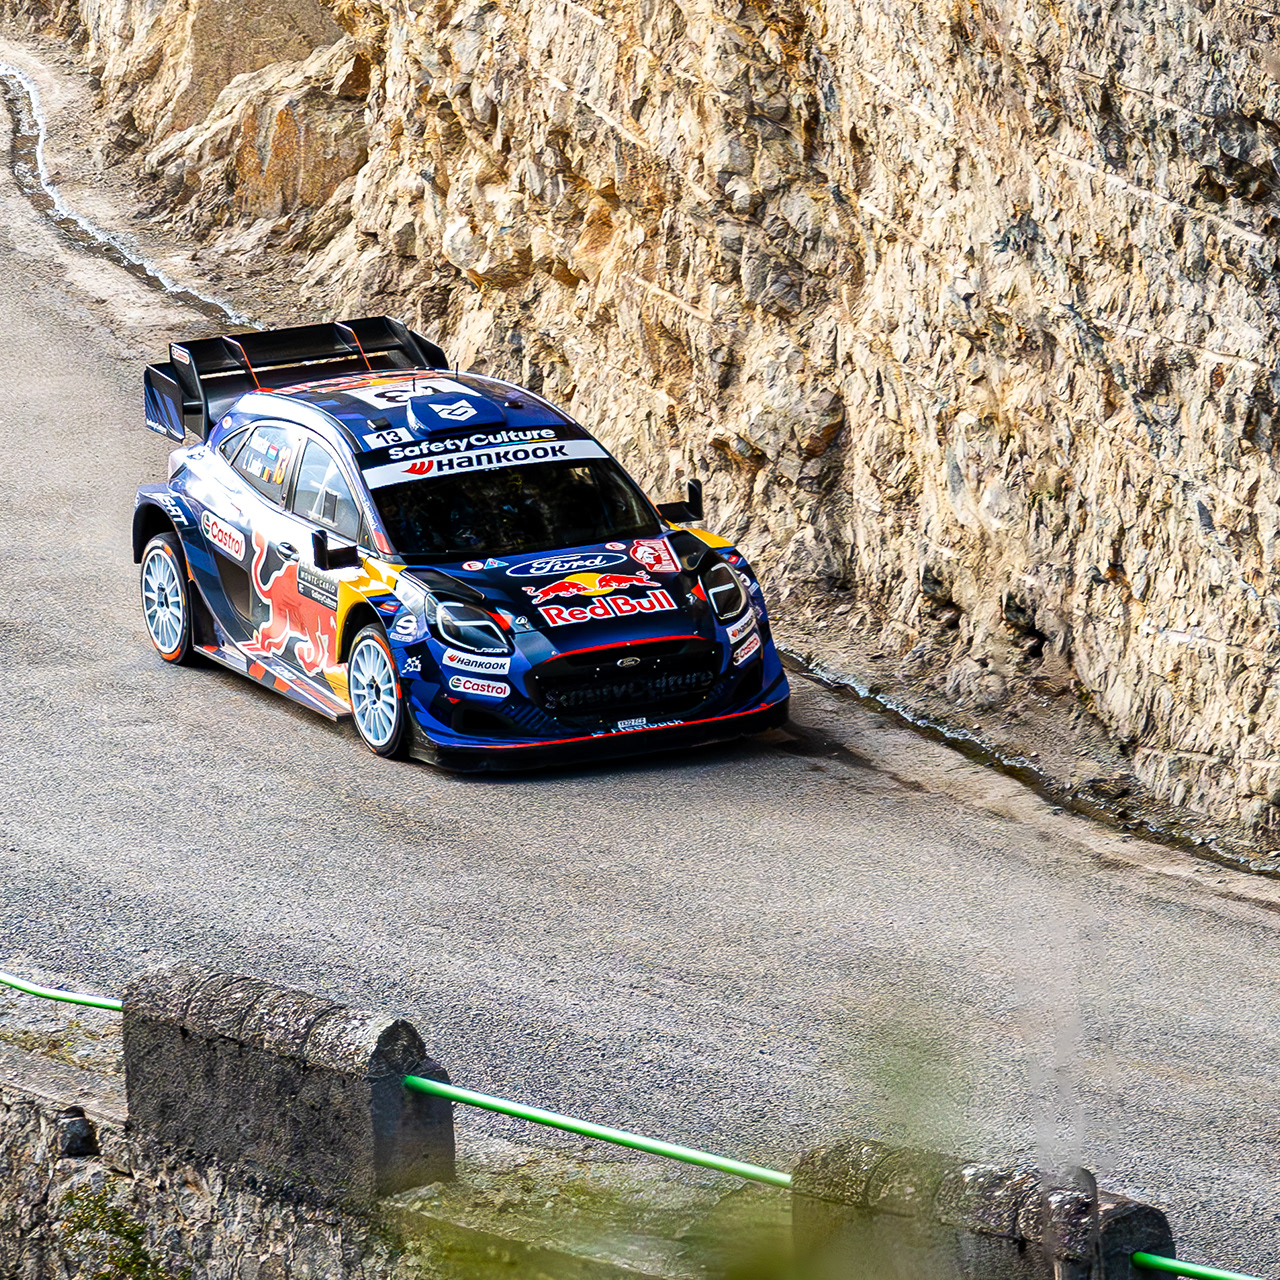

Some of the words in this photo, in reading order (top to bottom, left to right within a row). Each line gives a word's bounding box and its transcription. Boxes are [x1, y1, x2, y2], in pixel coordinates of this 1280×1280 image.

[375, 430, 403, 445] 13
[389, 428, 556, 460] SafetyCulture
[211, 521, 243, 557] Castrol
[529, 555, 607, 574] Ford
[538, 597, 615, 627] Red
[609, 589, 678, 617] Bull
[463, 680, 507, 695] Castrol
